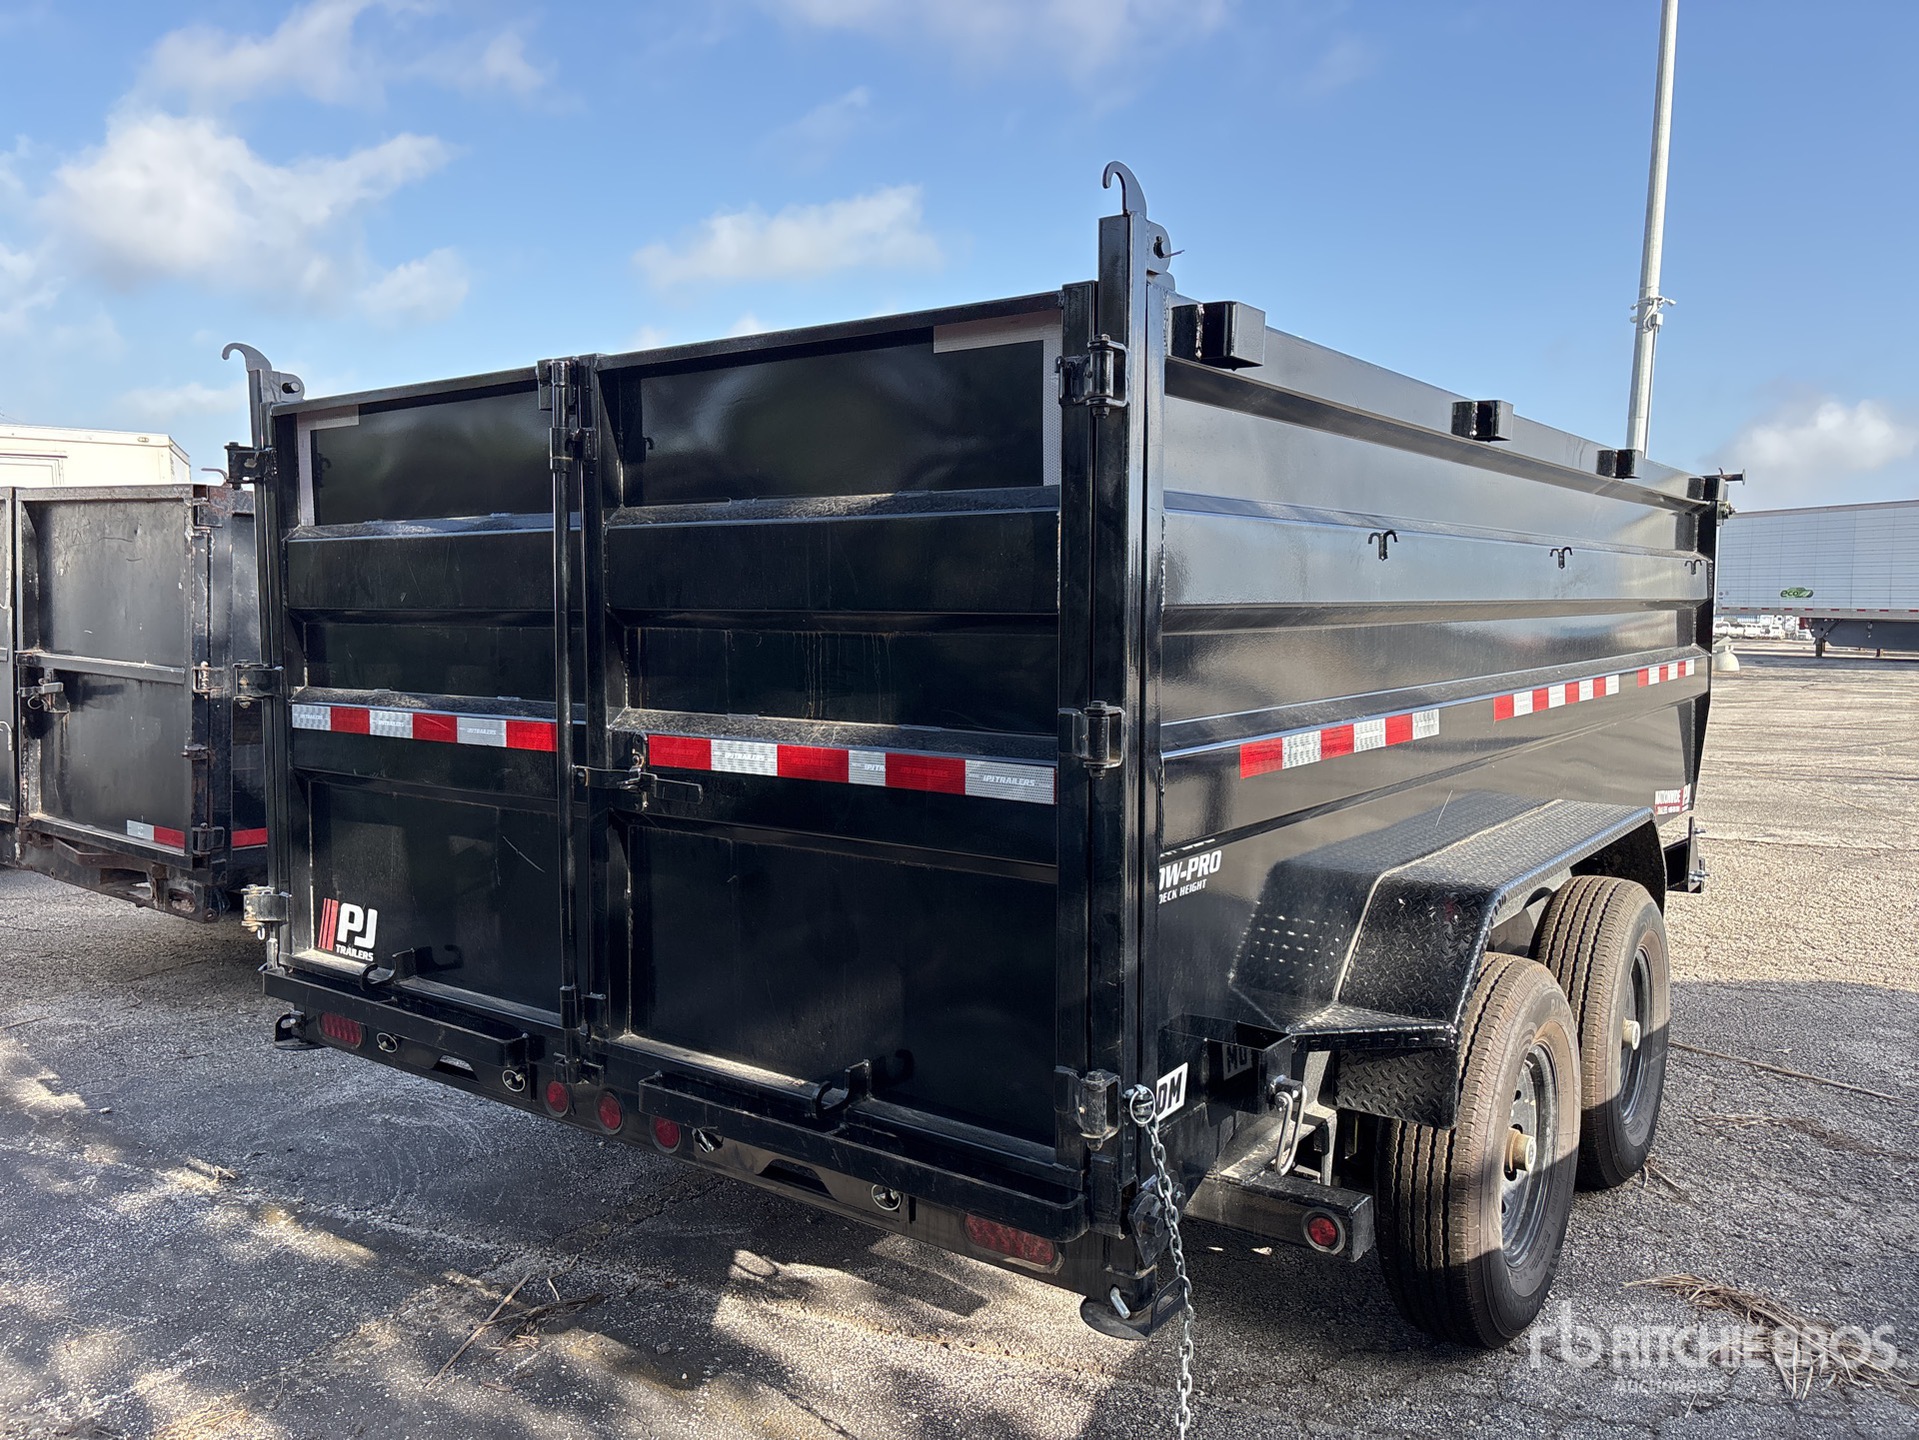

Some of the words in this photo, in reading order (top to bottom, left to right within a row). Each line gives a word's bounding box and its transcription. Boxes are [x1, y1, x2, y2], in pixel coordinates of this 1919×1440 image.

[1780, 589, 1799, 598] eco
[1179, 878, 1207, 897] HEIGHT
[336, 902, 378, 950] PJ
[335, 943, 374, 962] TRAILERS
[1157, 1070, 1183, 1117] DM
